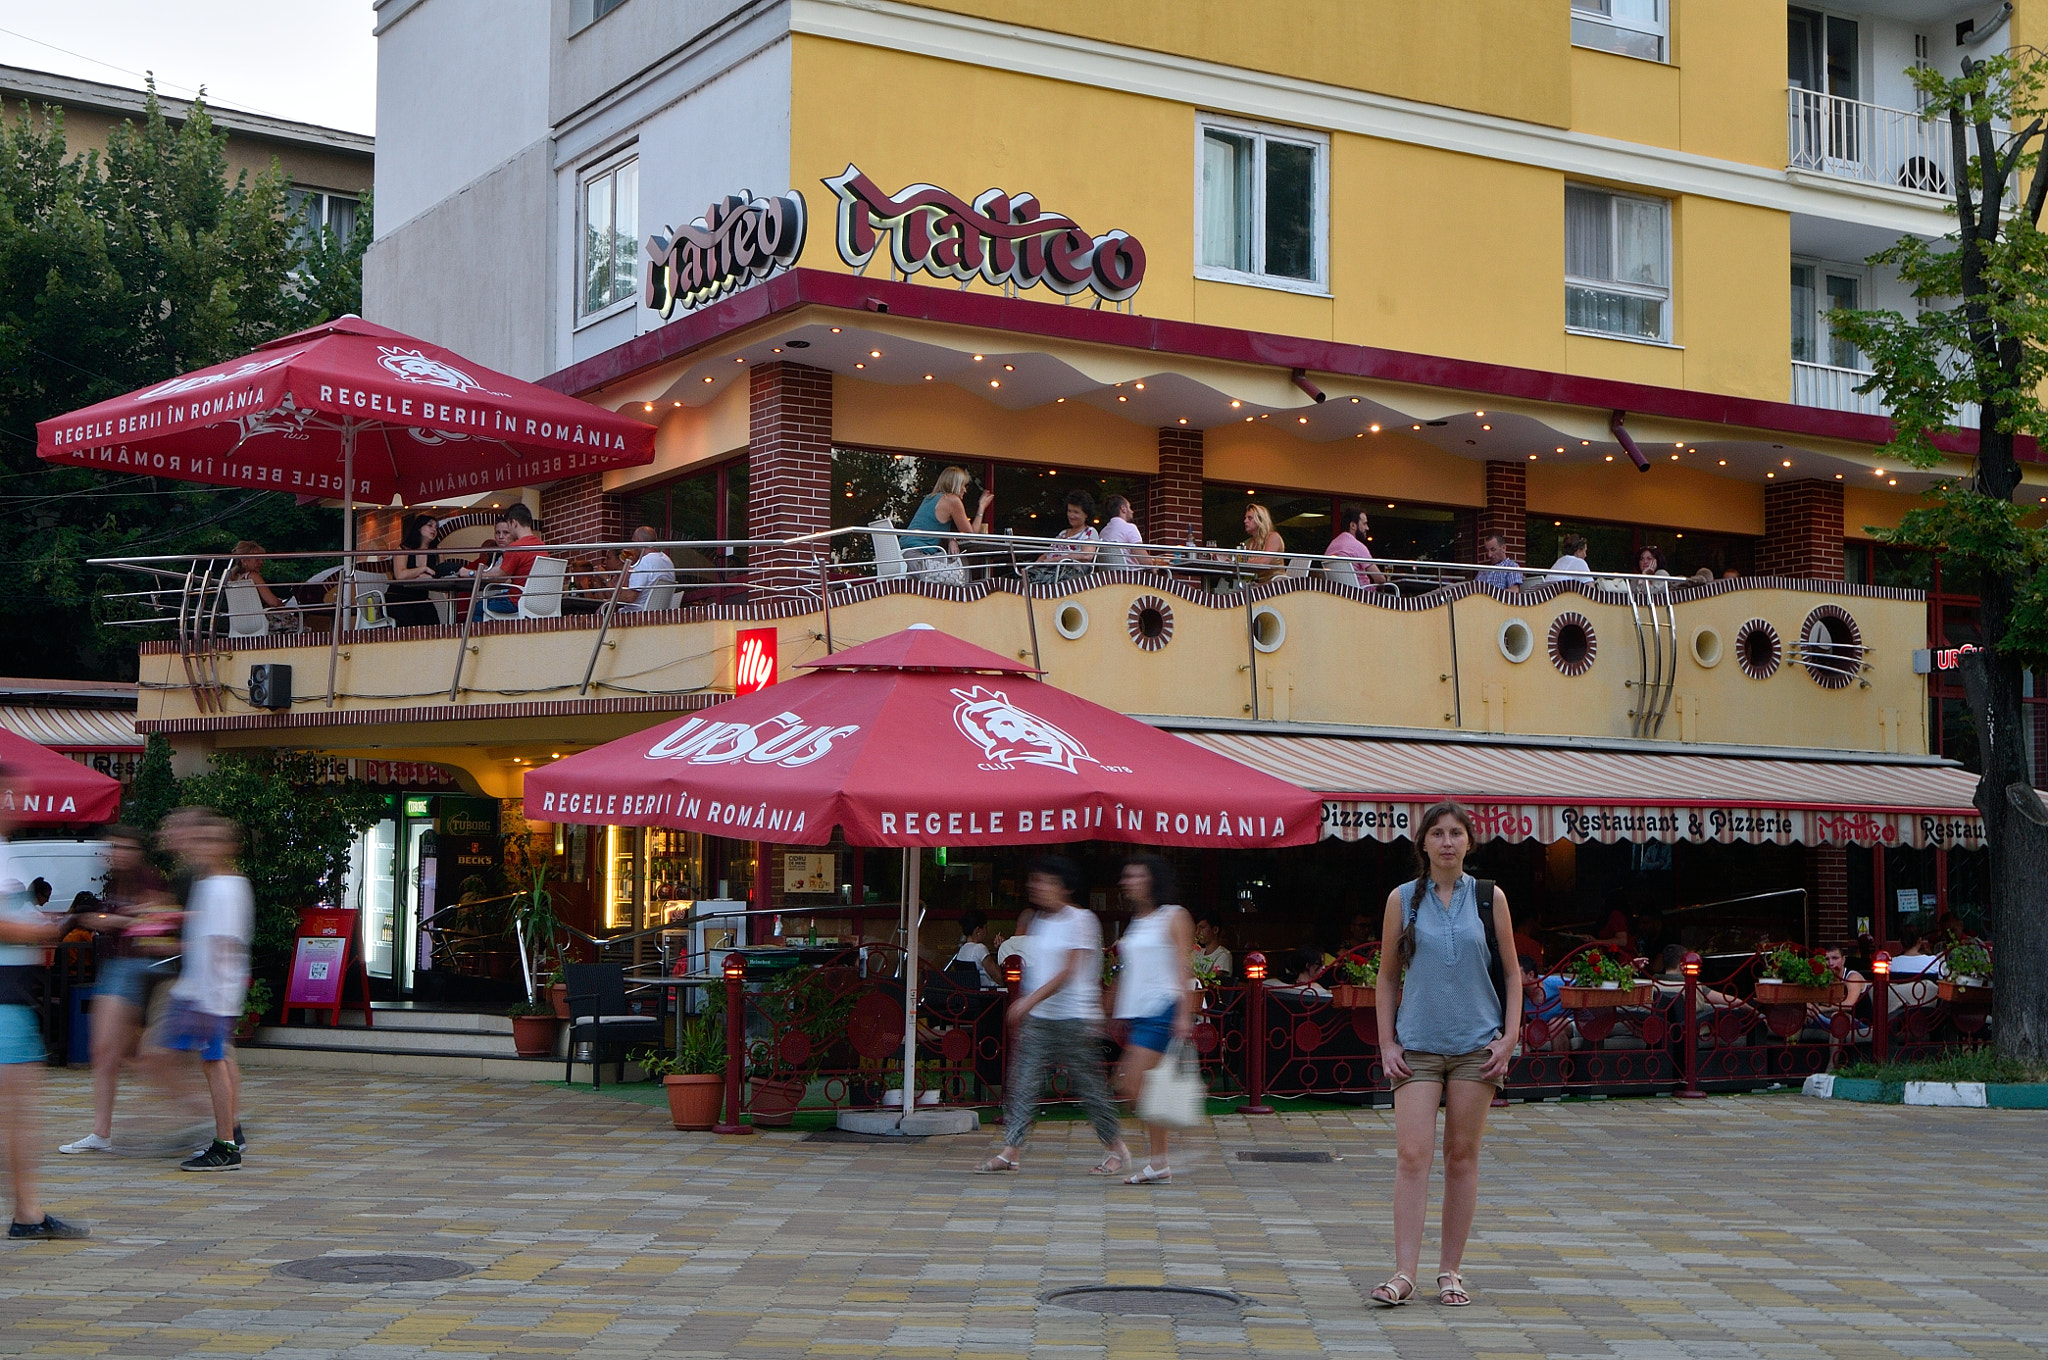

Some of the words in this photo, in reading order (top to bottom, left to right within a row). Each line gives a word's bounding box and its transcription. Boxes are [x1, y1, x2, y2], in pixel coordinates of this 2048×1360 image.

[820, 163, 1146, 300] Matteo
[645, 189, 806, 319] Matteo
[55, 420, 113, 446] REGELE
[119, 411, 162, 434] BERII
[167, 405, 184, 425] ÎN
[191, 387, 264, 420] ROMÂNIA
[320, 385, 413, 416] REGELE
[423, 402, 485, 427] BERII
[495, 410, 517, 432] ÎN
[526, 418, 626, 450] ROMÂNIA
[737, 638, 773, 691] illy
[644, 711, 860, 768] URSUS
[977, 763, 1016, 771] CLUJ
[452, 821, 491, 831] TUBORG
[543, 791, 617, 815] REGELE
[621, 794, 671, 815] BERII
[676, 791, 701, 819] ÎN
[707, 801, 806, 832] ROMÂNIA
[881, 811, 1004, 835] REGELE
[1018, 807, 1103, 833] BERII
[1116, 803, 1142, 831] ÎN
[1156, 811, 1285, 838] ROMÂNIA
[1562, 808, 1679, 838] Restaurant
[1688, 814, 1703, 838] &
[1710, 810, 1792, 835] Pizzerie
[1818, 813, 1895, 842] Matteo
[1920, 817, 1987, 844] Restau
[458, 856, 492, 865] BECK'S
